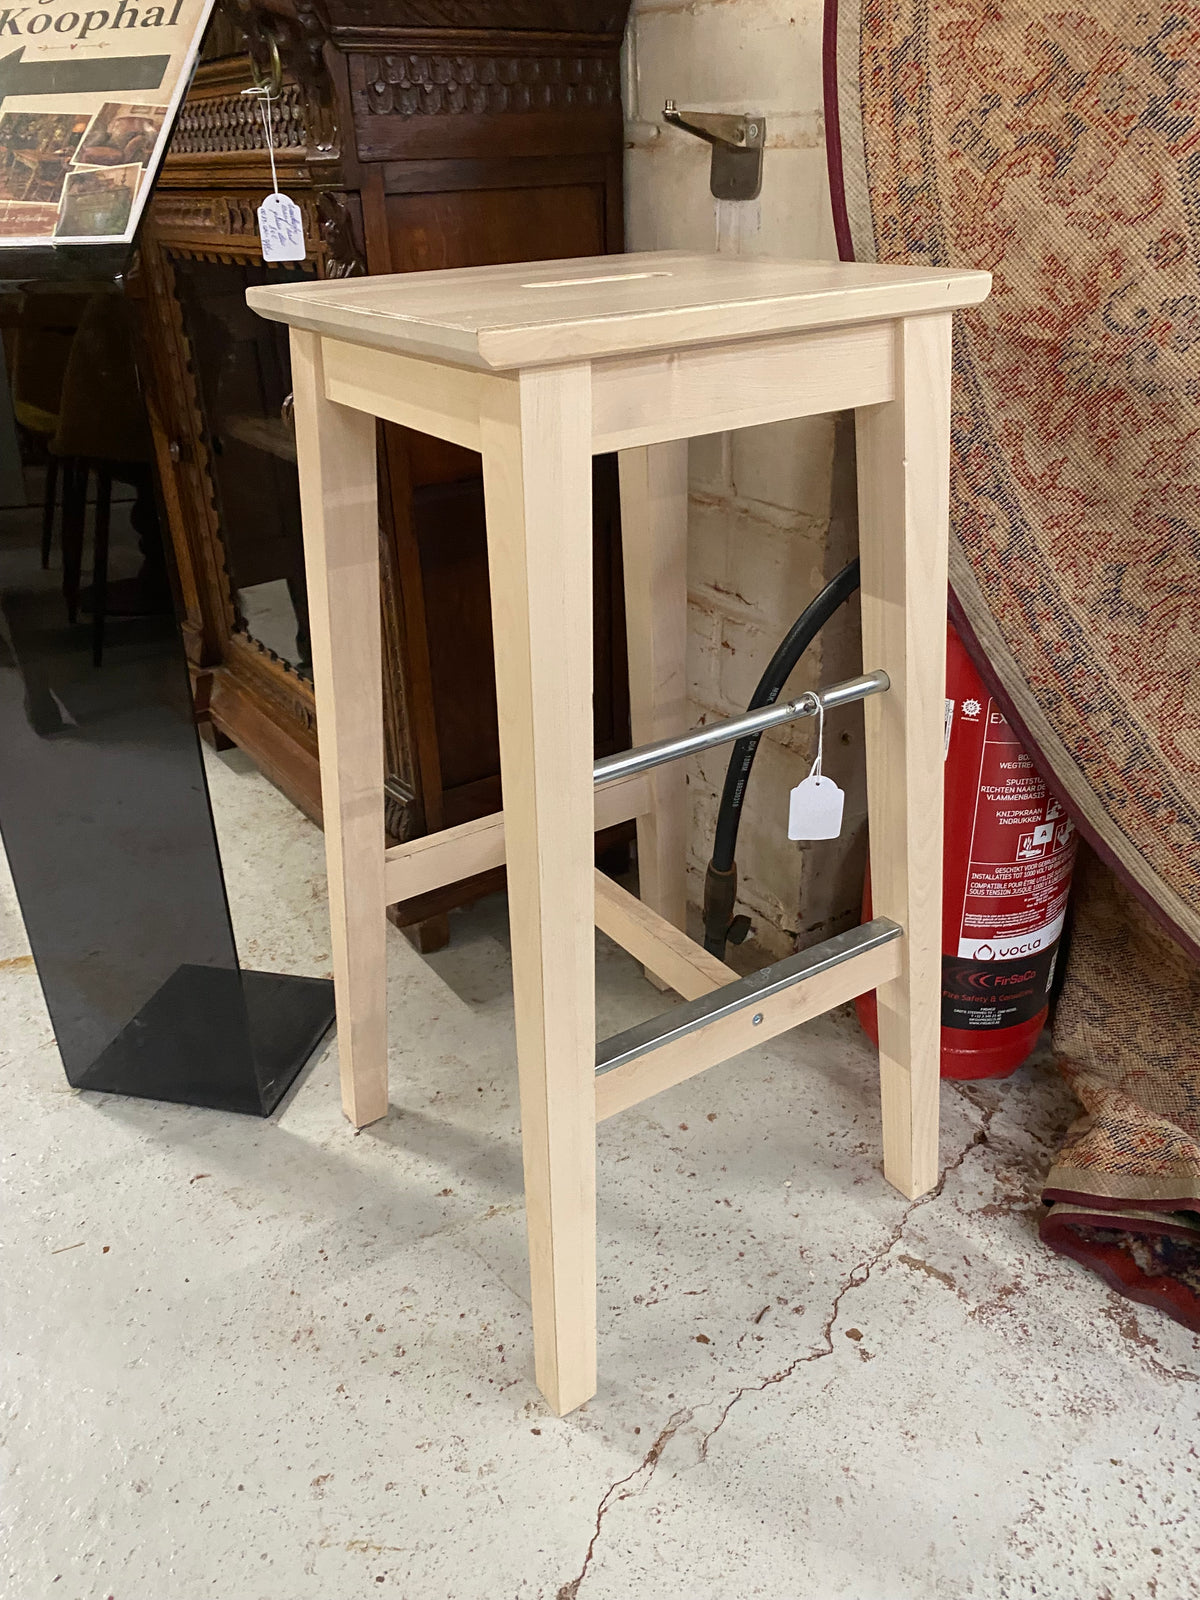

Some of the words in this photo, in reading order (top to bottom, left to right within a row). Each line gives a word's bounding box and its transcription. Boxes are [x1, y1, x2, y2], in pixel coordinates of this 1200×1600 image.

[0, 0, 183, 39] Koophal
[980, 785, 1015, 793] RICHTEN
[1016, 785, 1036, 793] NAAR
[986, 791, 1045, 800] VLAMMENBASIS
[996, 808, 1042, 818] KNIJPKRAAN
[998, 815, 1041, 825] INDRUKKEN
[995, 866, 1022, 874] GESCHIKT
[971, 872, 1012, 880] INSTALLATIES
[985, 888, 1011, 896] TENSION
